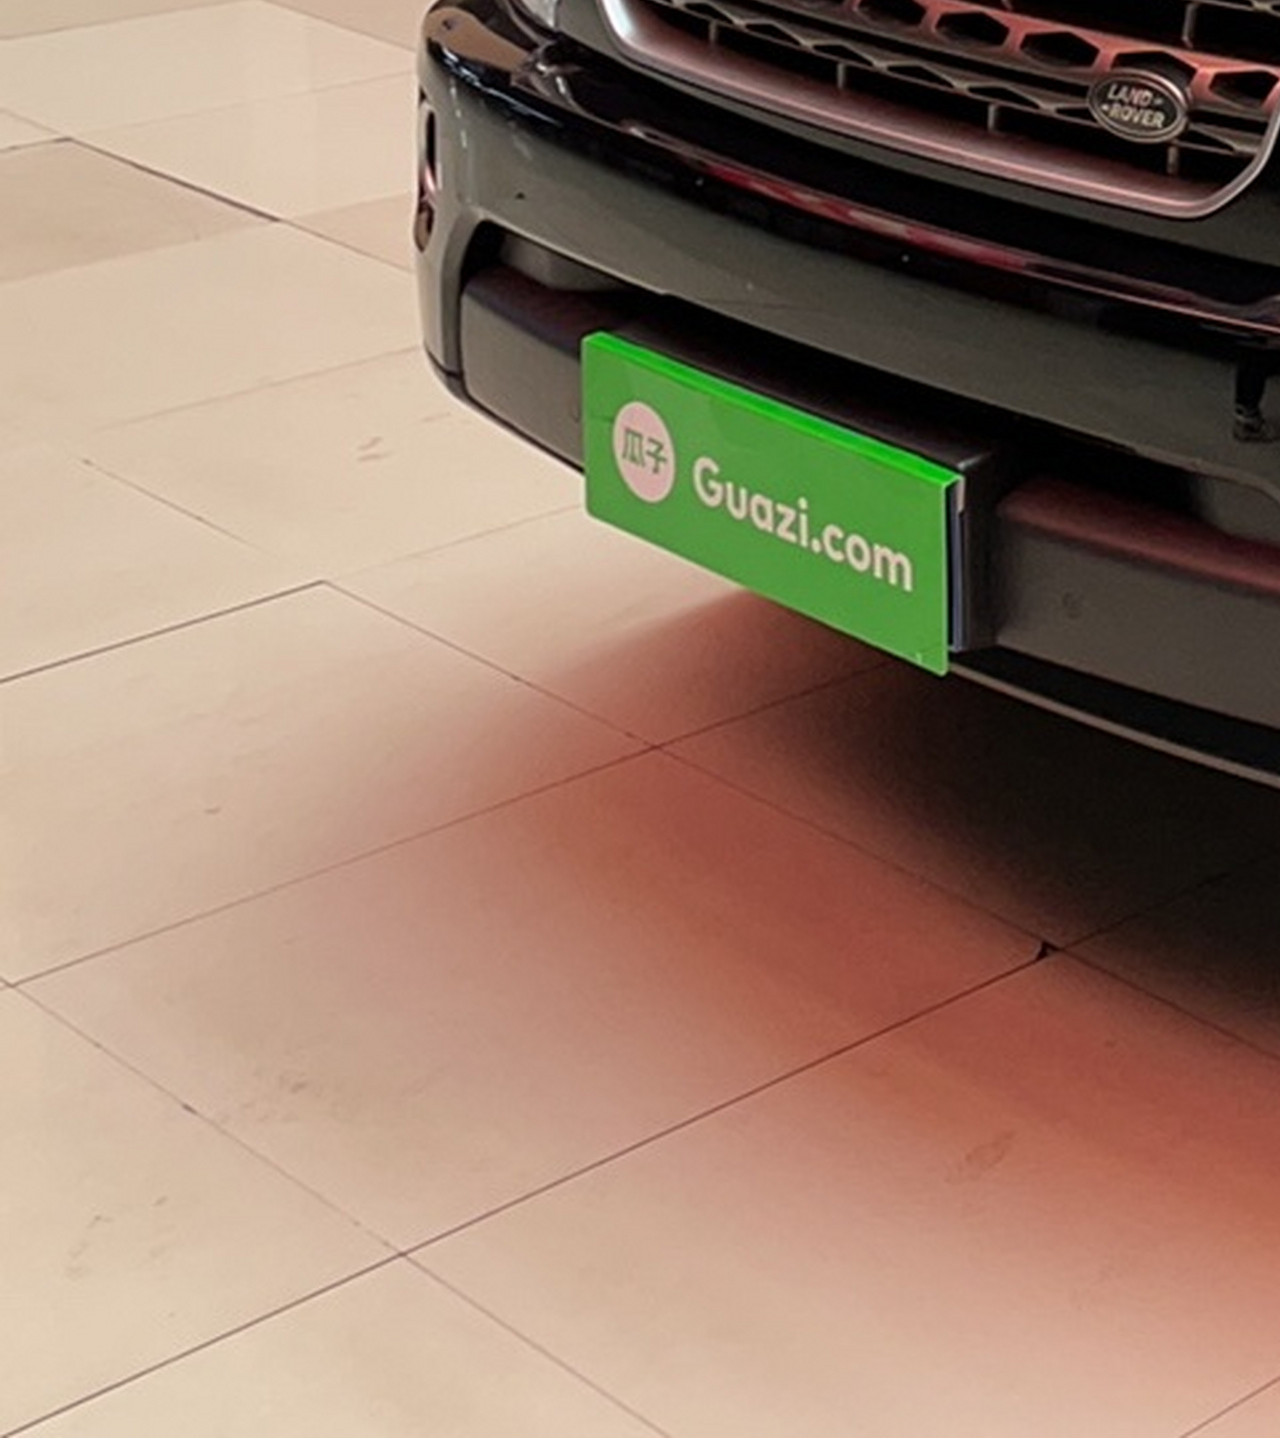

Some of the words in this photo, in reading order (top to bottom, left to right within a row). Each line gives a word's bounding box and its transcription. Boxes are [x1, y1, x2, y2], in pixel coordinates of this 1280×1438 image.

[1107, 83, 1154, 107] LAND
[1108, 103, 1165, 129] ROVER
[621, 427, 667, 475] 瓜子
[693, 456, 913, 592] Guazi.com
